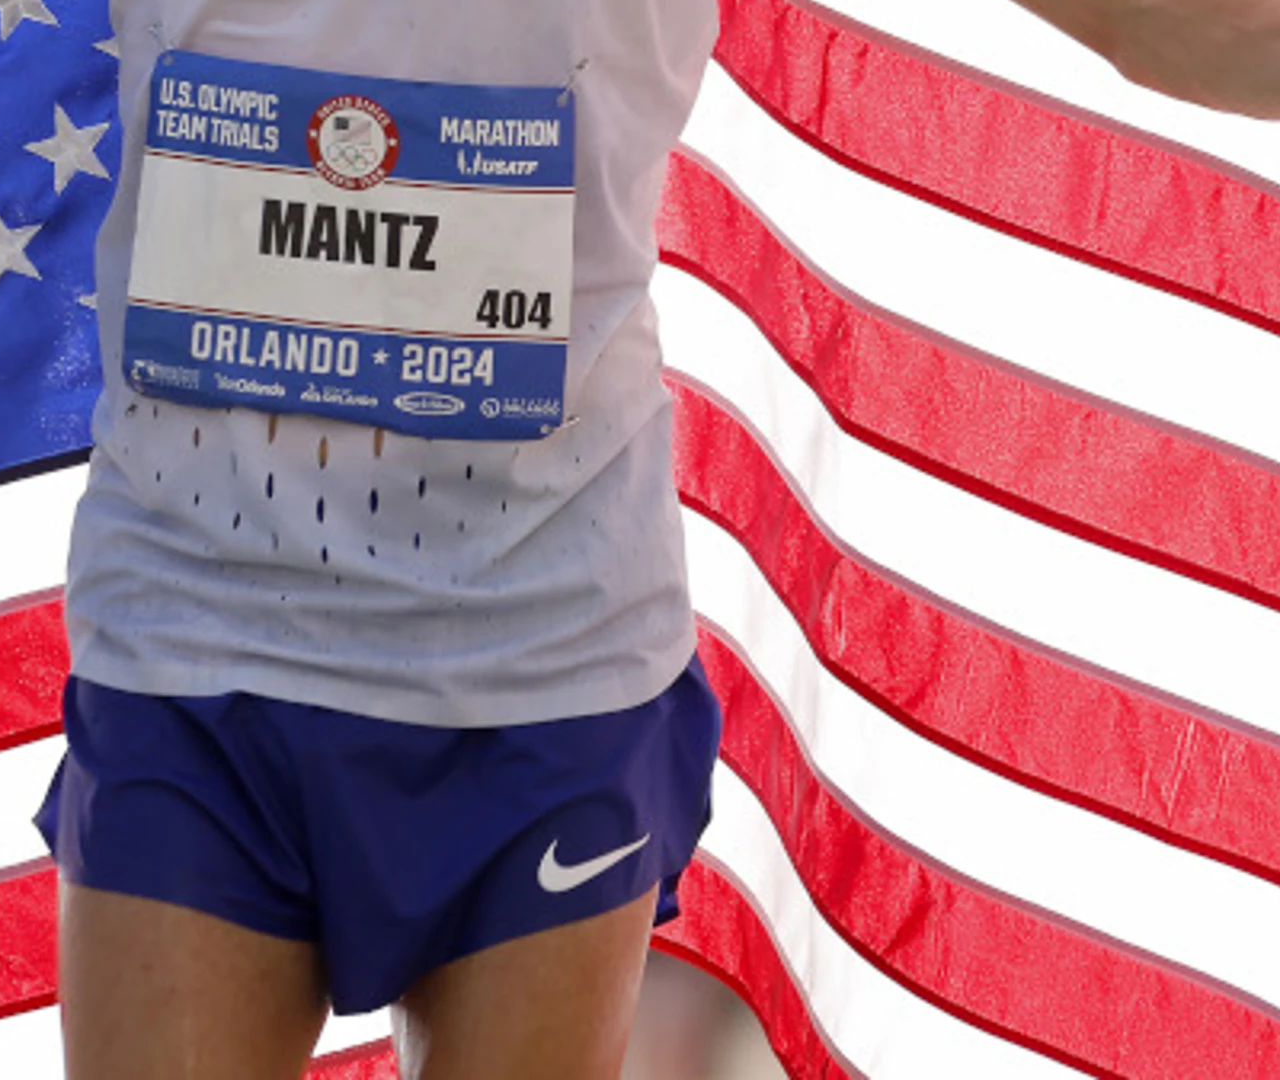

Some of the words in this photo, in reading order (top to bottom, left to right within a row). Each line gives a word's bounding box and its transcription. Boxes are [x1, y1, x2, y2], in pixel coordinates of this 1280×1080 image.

[160, 78, 196, 108] U.S.
[198, 84, 280, 120] OLYMPIC
[156, 110, 208, 143] TEAM
[210, 117, 280, 152] TRIALS
[440, 116, 560, 146] MARATHON
[259, 199, 440, 271] MANTZ
[476, 289, 553, 330] 404
[190, 322, 360, 377] ORLANDO
[401, 343, 495, 386] 2024
